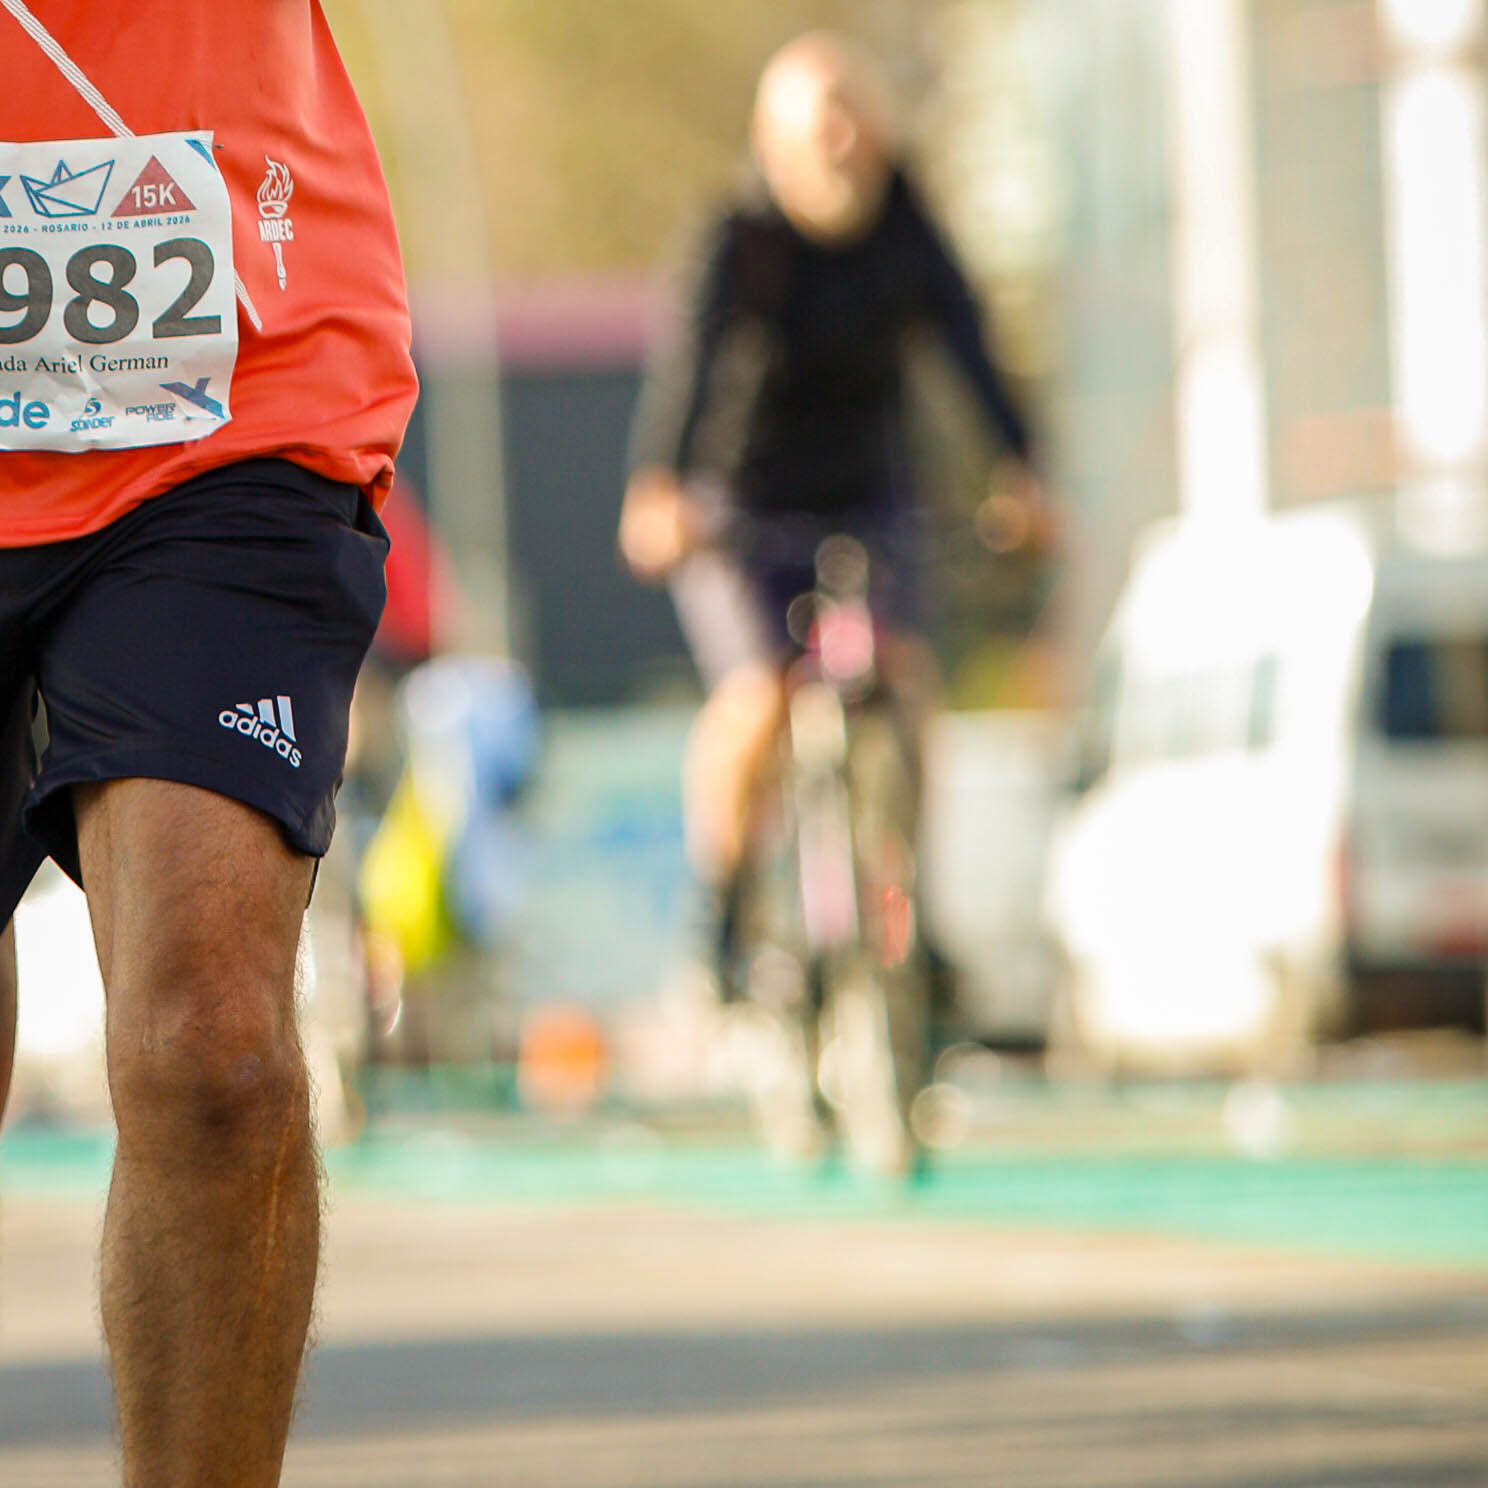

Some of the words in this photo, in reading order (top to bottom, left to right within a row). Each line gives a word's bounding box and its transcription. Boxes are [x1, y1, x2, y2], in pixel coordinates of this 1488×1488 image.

[132, 182, 177, 209] 15K
[3, 224, 29, 233] 2026
[41, 223, 89, 233] ROSARIO
[101, 221, 113, 231] 12
[116, 219, 129, 230] DE
[133, 216, 163, 229] ABRIL
[166, 215, 190, 225] 2026
[34, 355, 83, 374] Ariel
[89, 353, 169, 372] German
[125, 402, 176, 416] POWER
[218, 710, 302, 768] adidas
